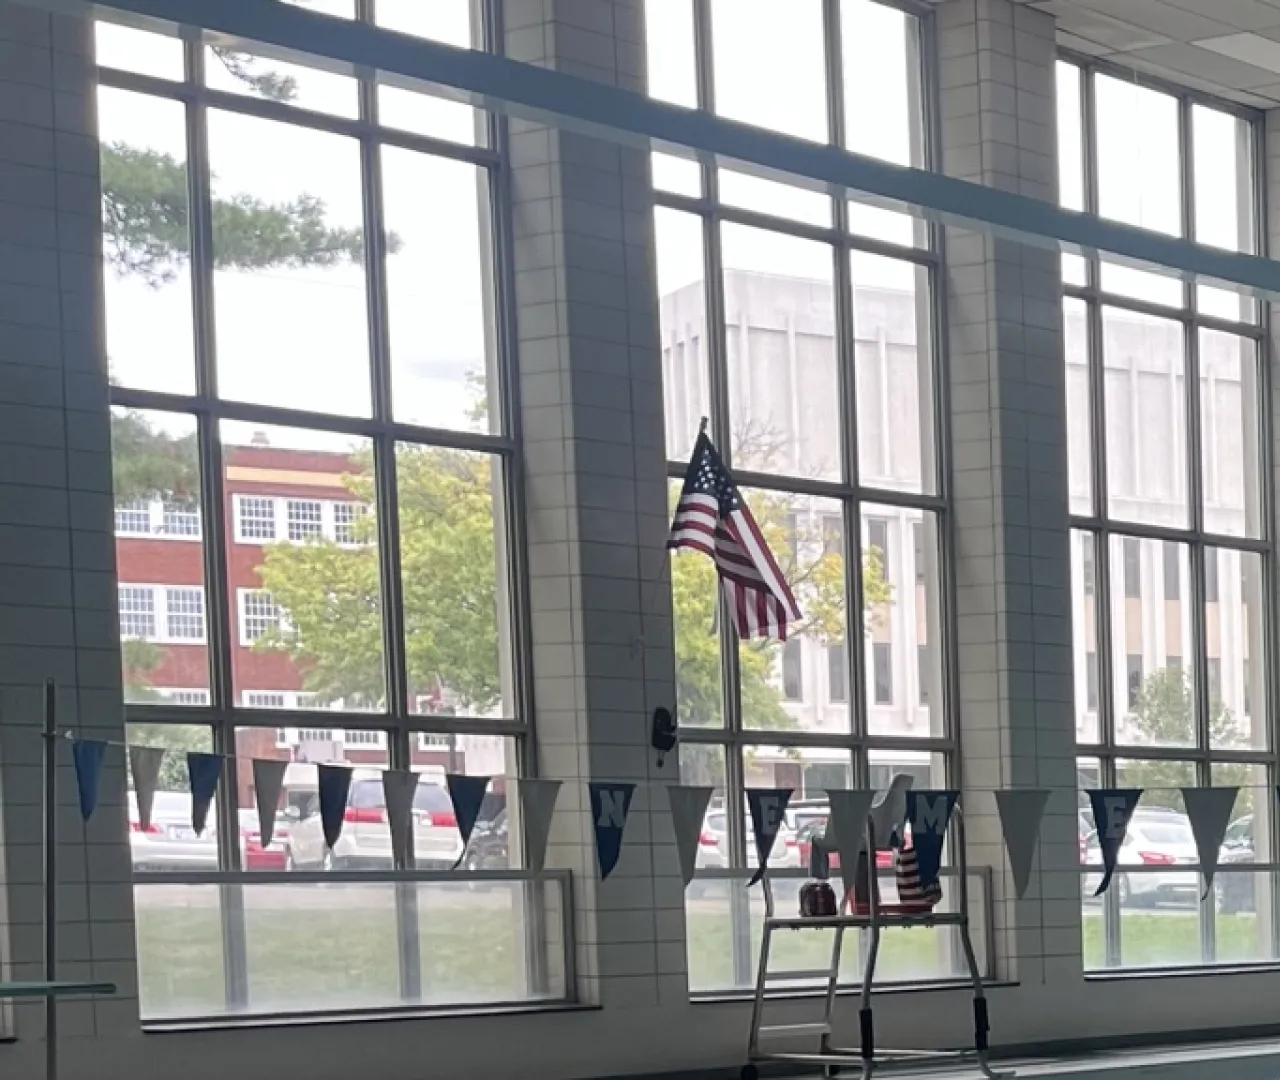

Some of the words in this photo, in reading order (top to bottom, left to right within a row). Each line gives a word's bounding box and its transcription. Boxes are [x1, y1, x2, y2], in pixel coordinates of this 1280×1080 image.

[596, 789, 627, 828] N
[758, 796, 782, 835] E
[915, 794, 947, 835] M
[1104, 796, 1127, 839] E
